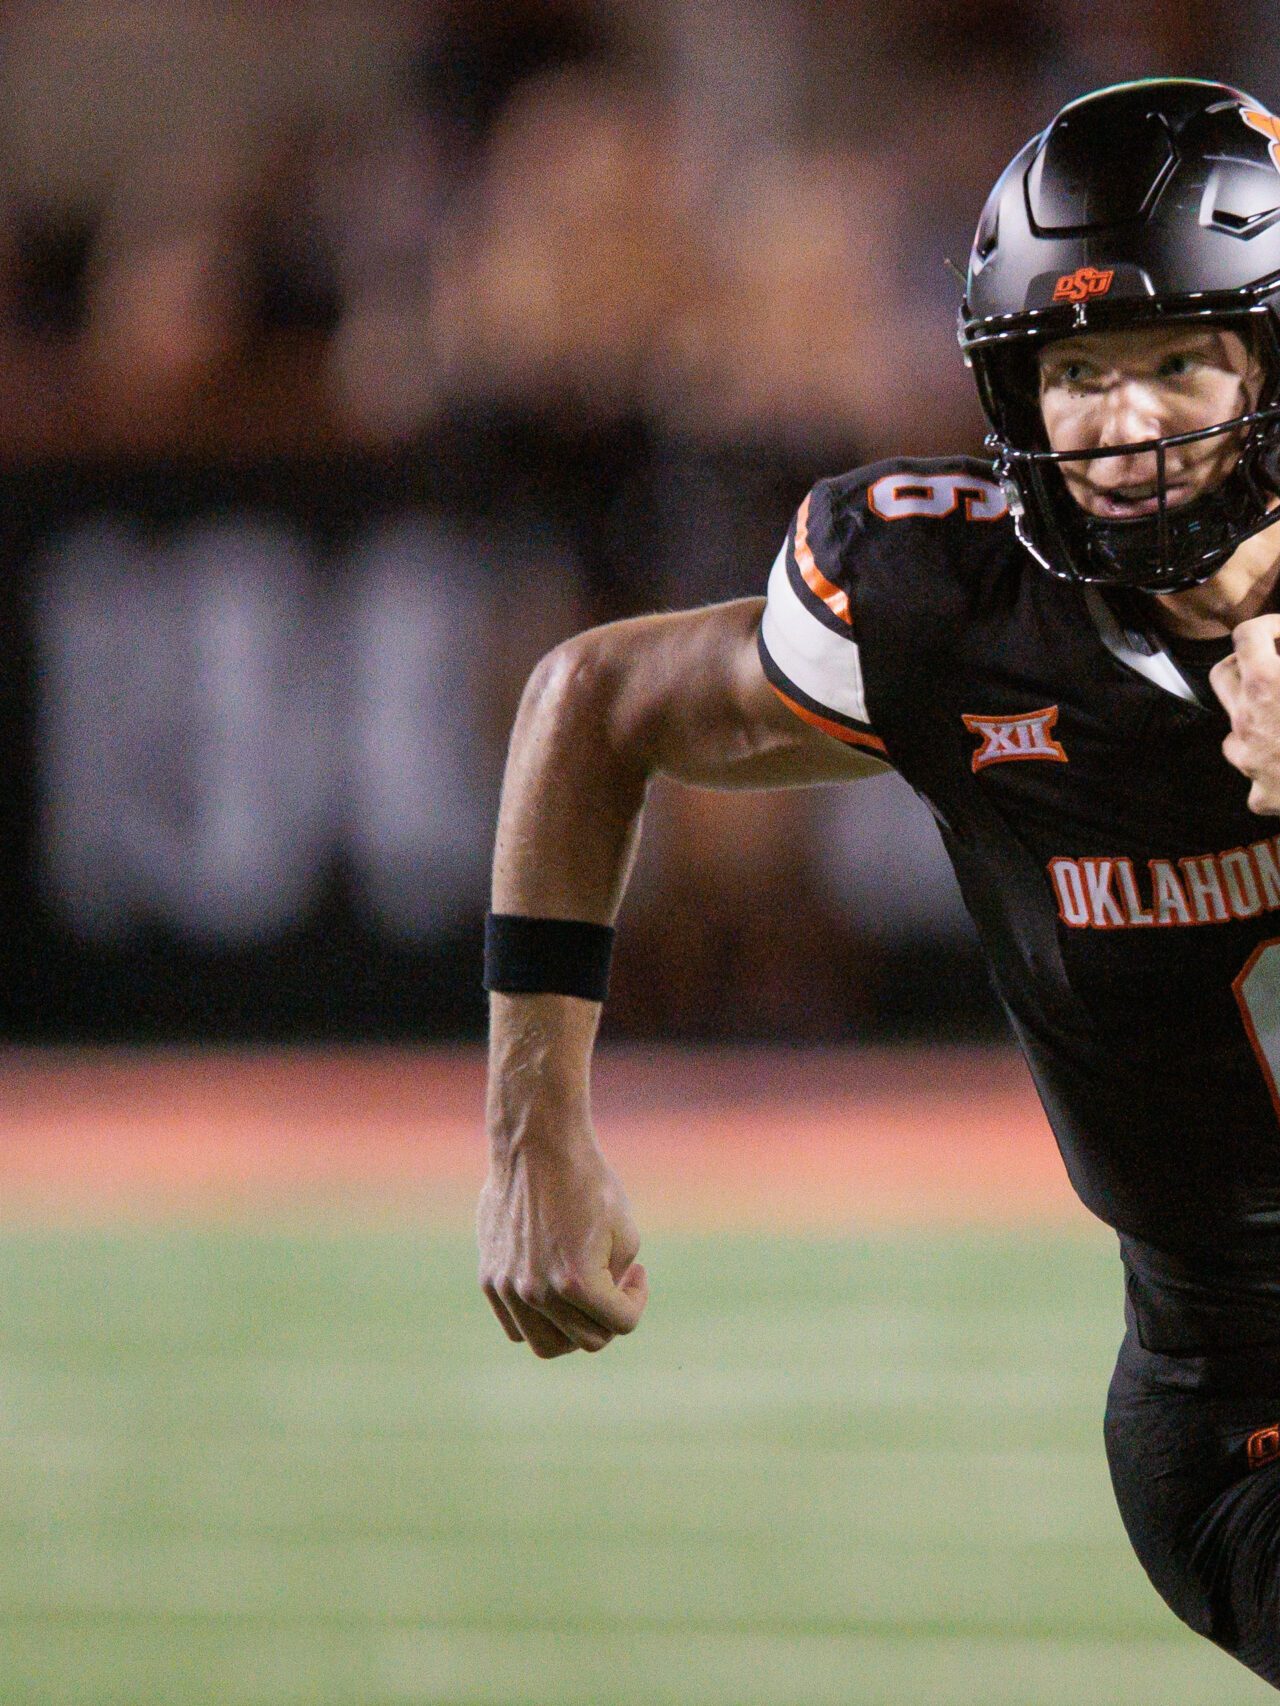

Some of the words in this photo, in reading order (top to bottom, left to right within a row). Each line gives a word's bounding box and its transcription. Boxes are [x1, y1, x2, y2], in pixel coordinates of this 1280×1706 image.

[1053, 267, 1115, 303] OSU
[867, 472, 1010, 521] 6
[966, 712, 1062, 766] XII
